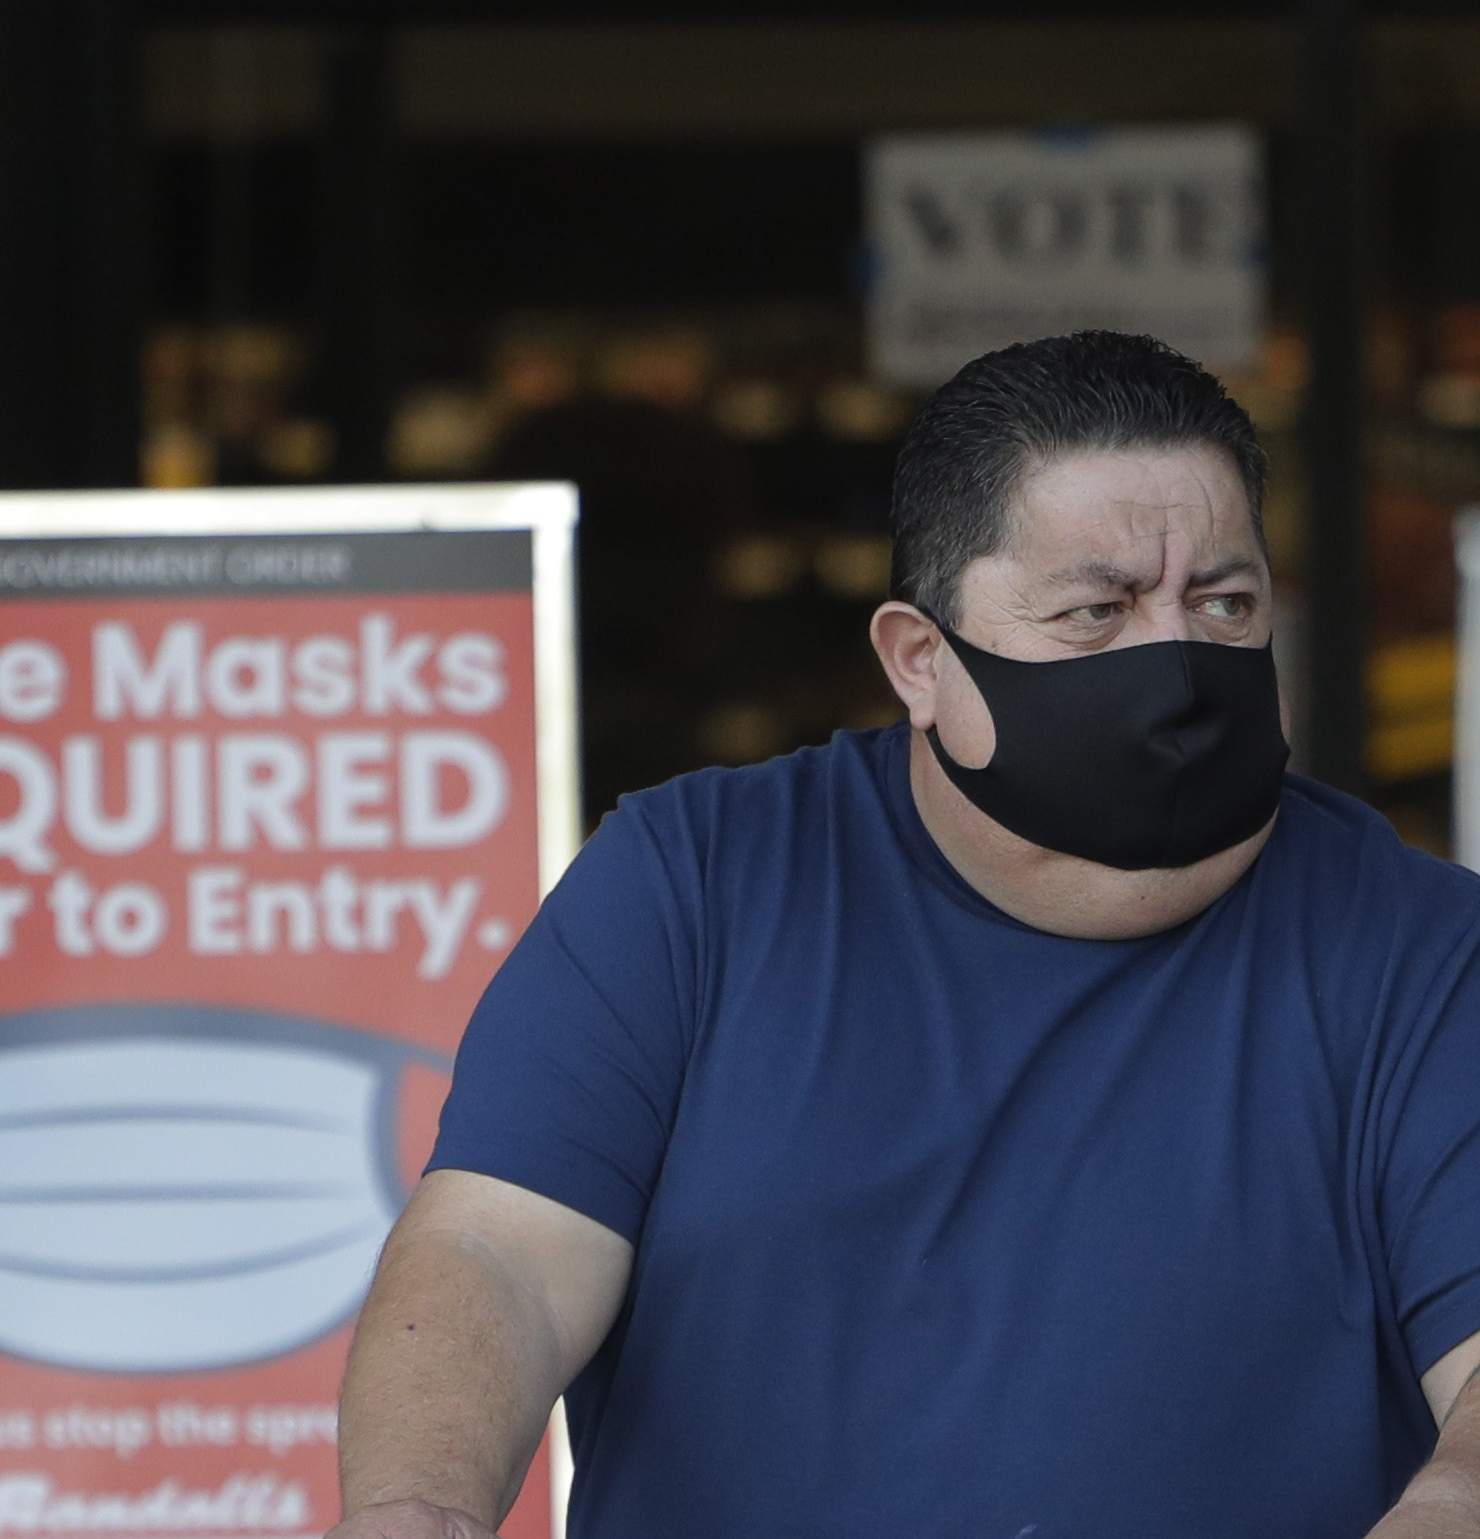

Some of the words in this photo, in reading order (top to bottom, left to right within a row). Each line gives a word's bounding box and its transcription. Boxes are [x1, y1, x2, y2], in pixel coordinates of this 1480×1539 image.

[893, 180, 1236, 274] VOTE
[226, 545, 352, 585] ORDER
[89, 613, 509, 722] Masks
[47, 870, 169, 958] to
[185, 865, 512, 981] Entry.
[42, 1405, 151, 1462] stop
[157, 1403, 237, 1448] the
